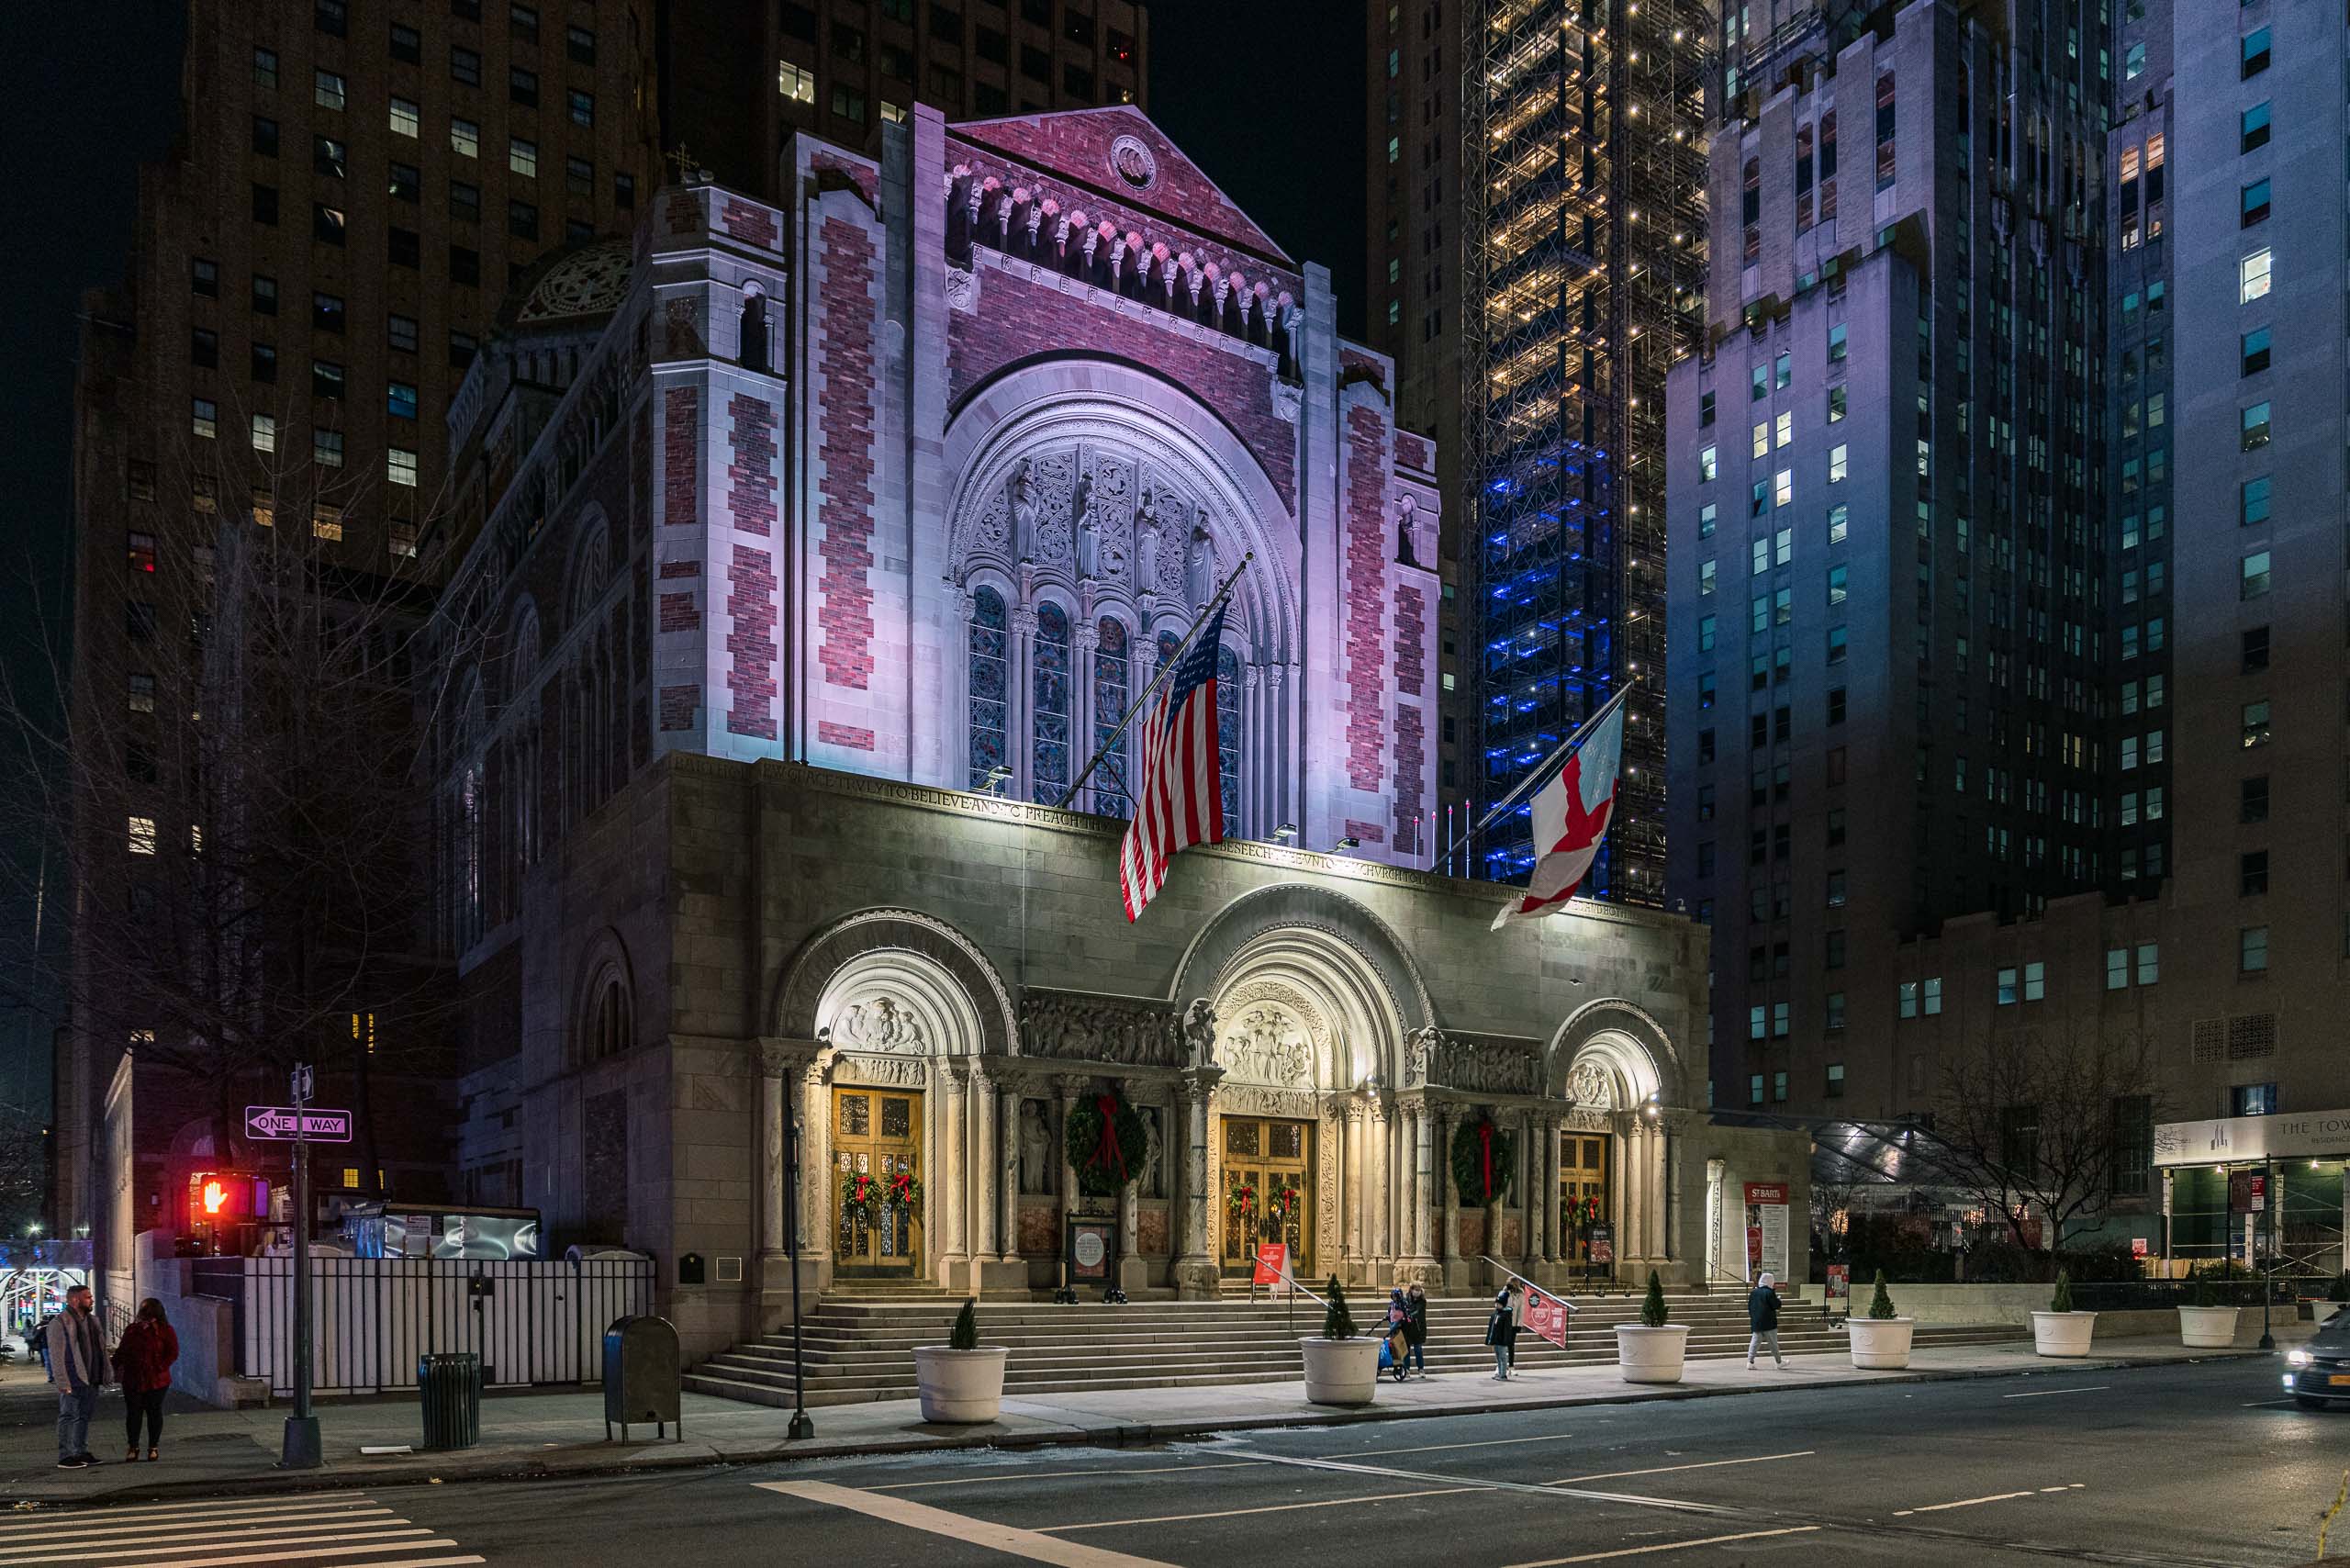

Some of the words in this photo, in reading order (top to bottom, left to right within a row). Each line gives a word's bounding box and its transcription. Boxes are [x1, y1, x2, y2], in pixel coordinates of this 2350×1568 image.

[886, 784, 908, 800] TO
[911, 790, 969, 811] BELIEVE
[1025, 807, 1079, 828] PREACH
[1220, 841, 1270, 860] BESEECH
[258, 1116, 292, 1130] ONE
[309, 1118, 341, 1132] WAY
[2279, 1122, 2311, 1135] THE
